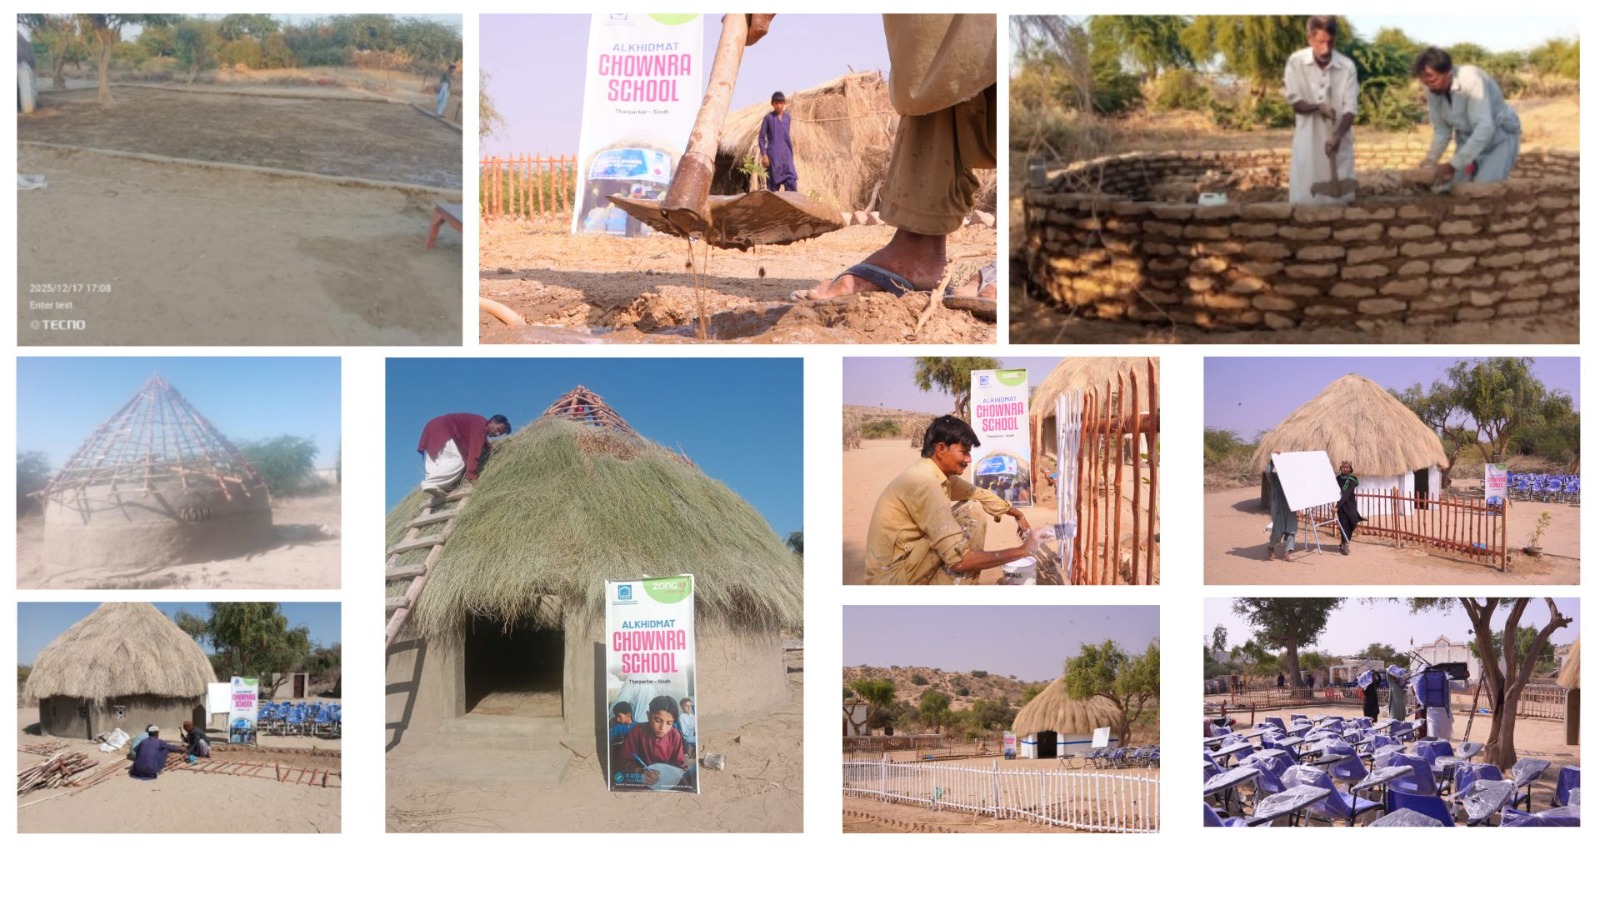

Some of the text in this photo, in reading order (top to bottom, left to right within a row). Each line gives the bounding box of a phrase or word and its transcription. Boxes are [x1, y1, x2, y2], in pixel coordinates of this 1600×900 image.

[612, 42, 680, 52] ALKHIDMAT
[598, 53, 692, 77] CHOWNRA
[607, 79, 679, 102] SCHOOL
[976, 402, 1025, 418] CHOWNRA
[982, 417, 1019, 432] SCHOOL
[622, 619, 676, 629] ALKHIDMAT
[612, 630, 686, 652] CHOWNRA
[621, 653, 678, 674] SCHOOL
